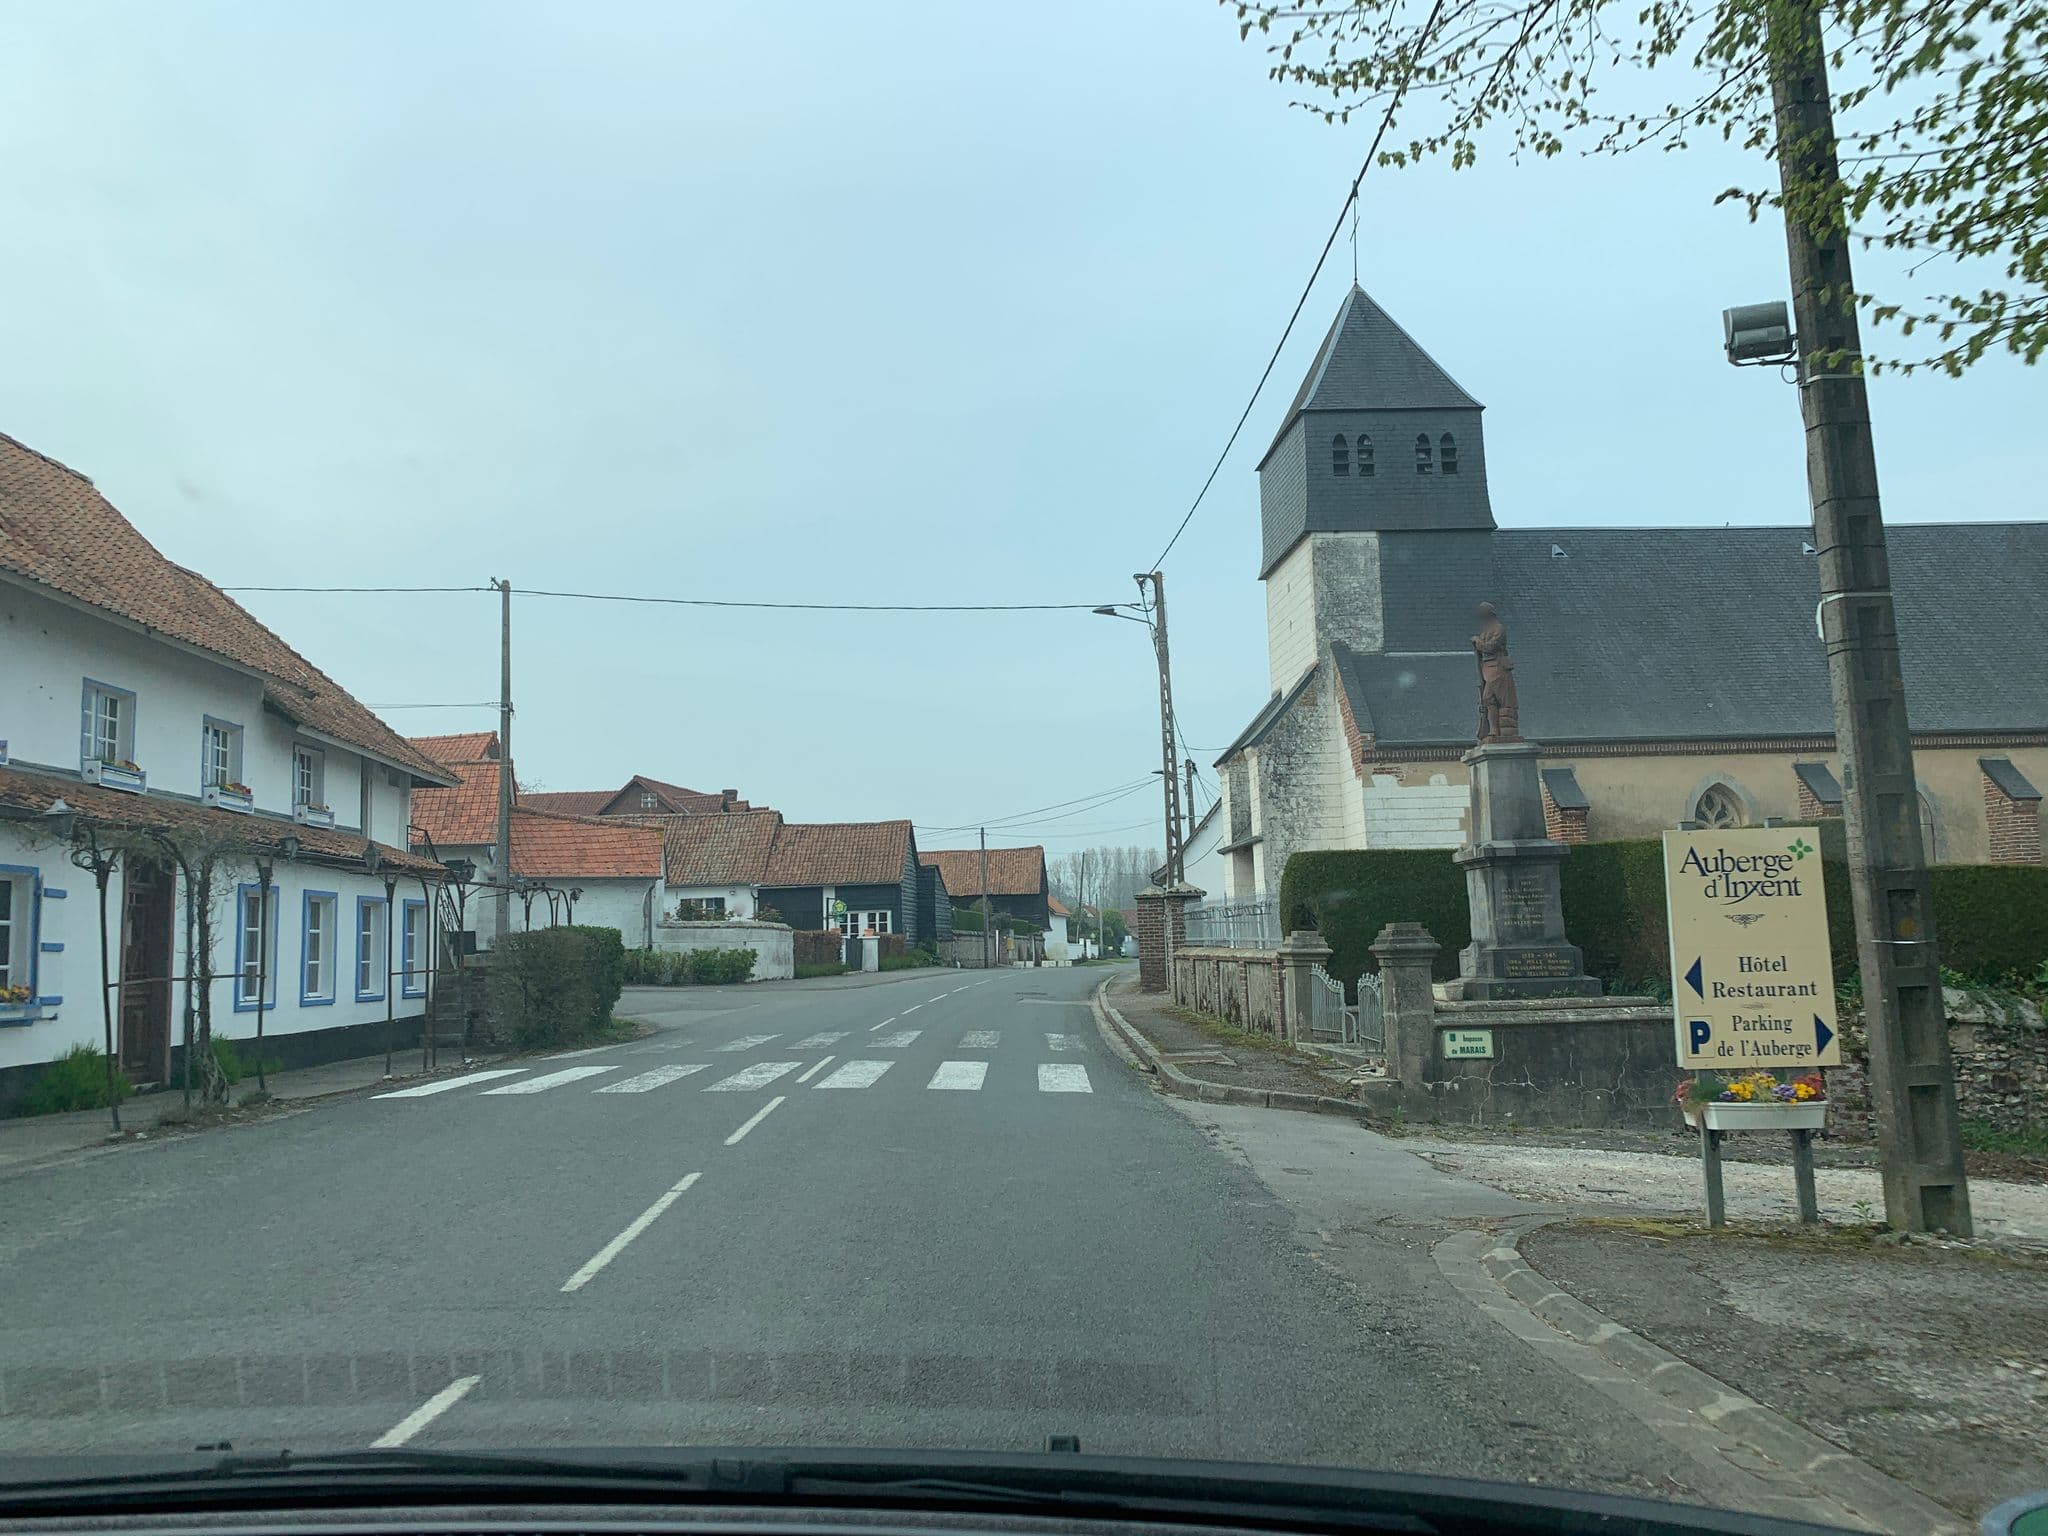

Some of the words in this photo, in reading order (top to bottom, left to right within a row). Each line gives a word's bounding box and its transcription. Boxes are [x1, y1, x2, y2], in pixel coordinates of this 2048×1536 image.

[1679, 846, 1794, 878] Auberge
[1738, 956, 1788, 973] Hôtel
[1712, 981, 1818, 998] Restaurant
[1731, 1014, 1793, 1034] Parking
[1689, 1020, 1711, 1055] P
[1459, 1046, 1487, 1054] MARAIS
[1717, 1040, 1735, 1057] de
[1740, 1039, 1812, 1059] l'Auberge
